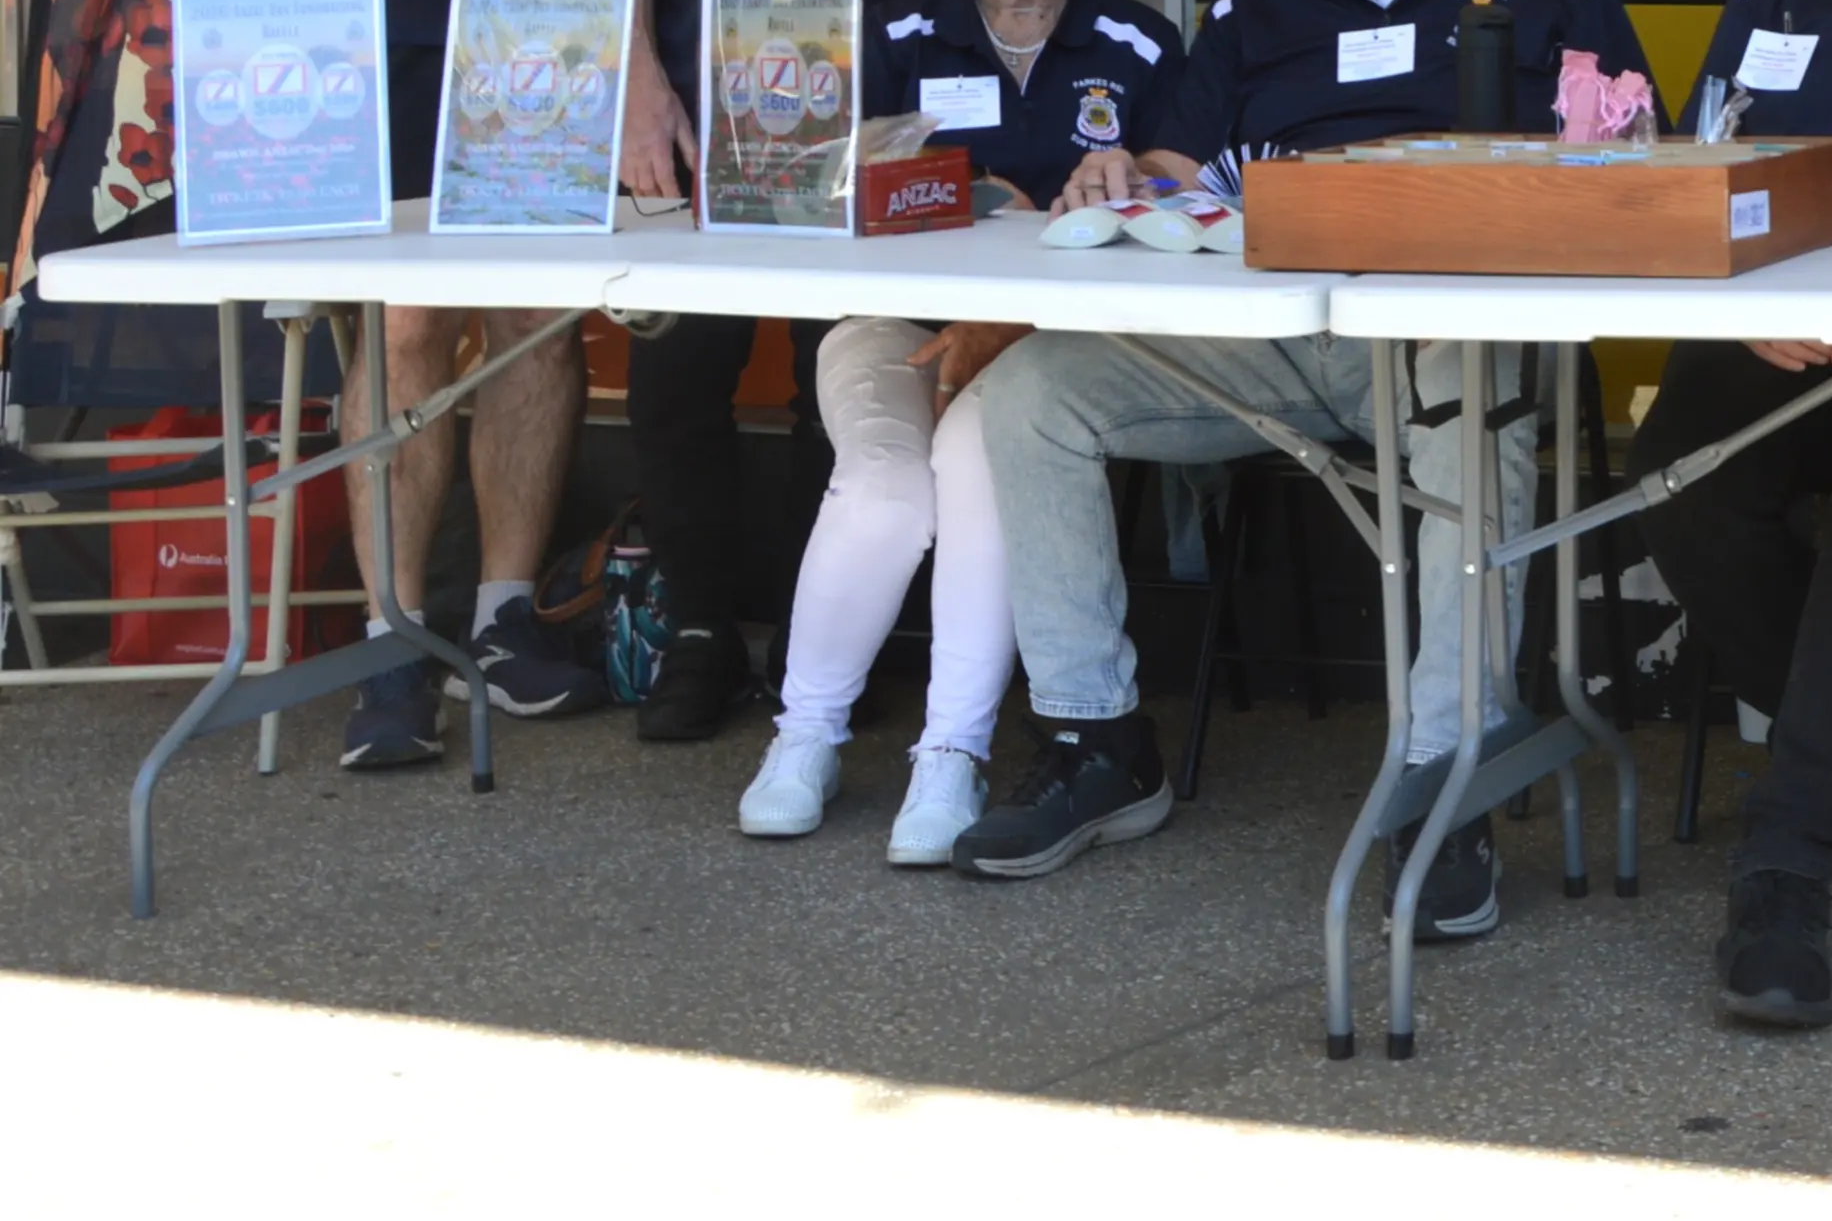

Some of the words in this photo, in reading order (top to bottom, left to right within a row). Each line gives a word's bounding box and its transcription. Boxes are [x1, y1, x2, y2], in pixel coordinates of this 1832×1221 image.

[760, 92, 800, 112] $600
[886, 180, 958, 218] ANZAC
[179, 551, 223, 566] Australia
